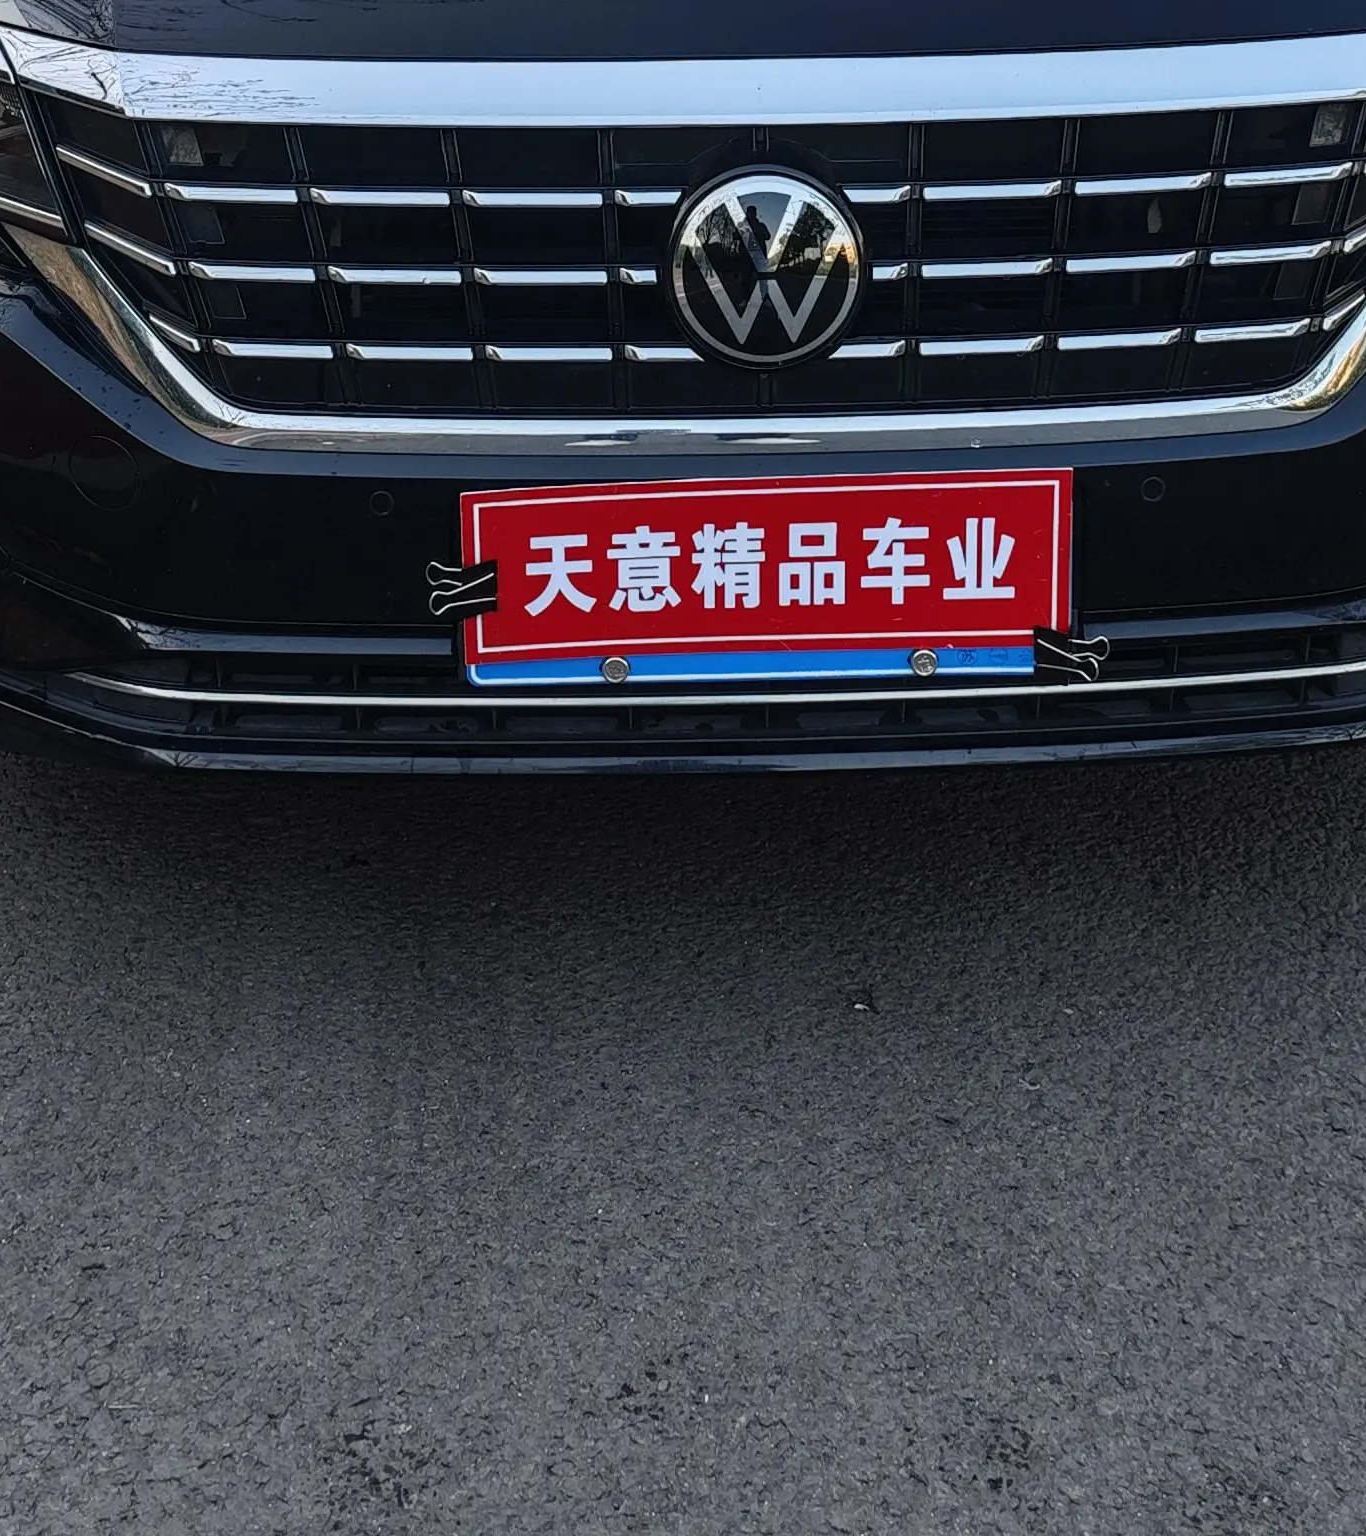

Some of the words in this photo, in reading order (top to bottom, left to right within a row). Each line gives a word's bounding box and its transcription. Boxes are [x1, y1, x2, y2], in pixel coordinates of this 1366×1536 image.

[524, 516, 1016, 616] 天意精品车业
